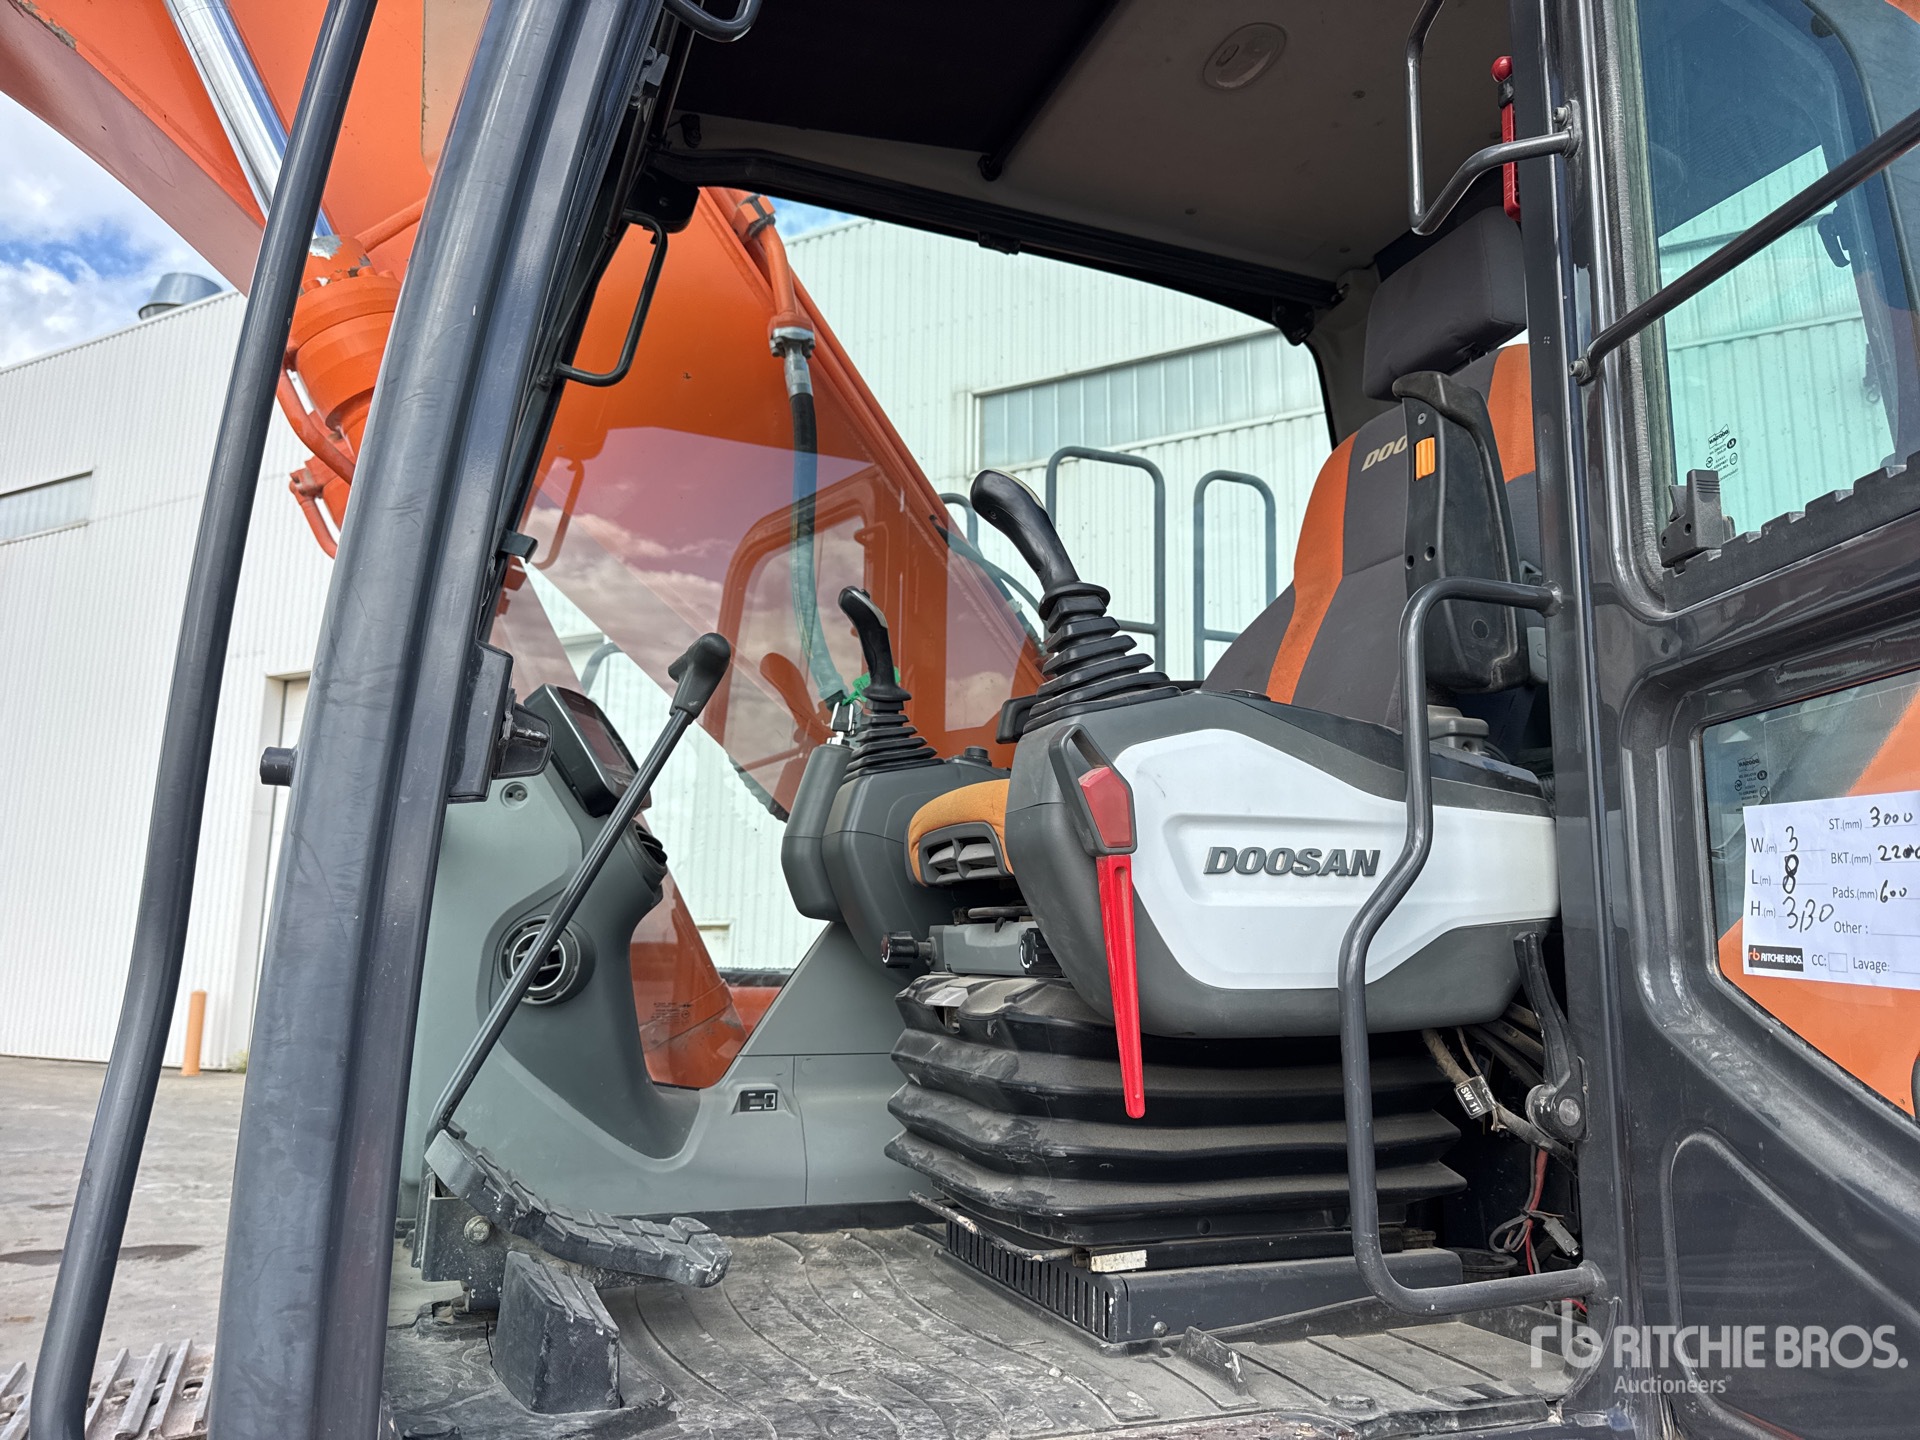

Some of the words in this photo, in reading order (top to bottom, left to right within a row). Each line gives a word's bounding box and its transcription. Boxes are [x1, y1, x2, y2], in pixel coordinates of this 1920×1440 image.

[1869, 806, 1913, 828] 3000
[1785, 825, 1799, 852] 3
[1203, 846, 1381, 876] DOOSAN
[1880, 880, 1908, 903] 600
[1761, 953, 1784, 963] RITCHIE
[1853, 957, 1890, 973] Lavage:
[1460, 1086, 1474, 1101] SW
